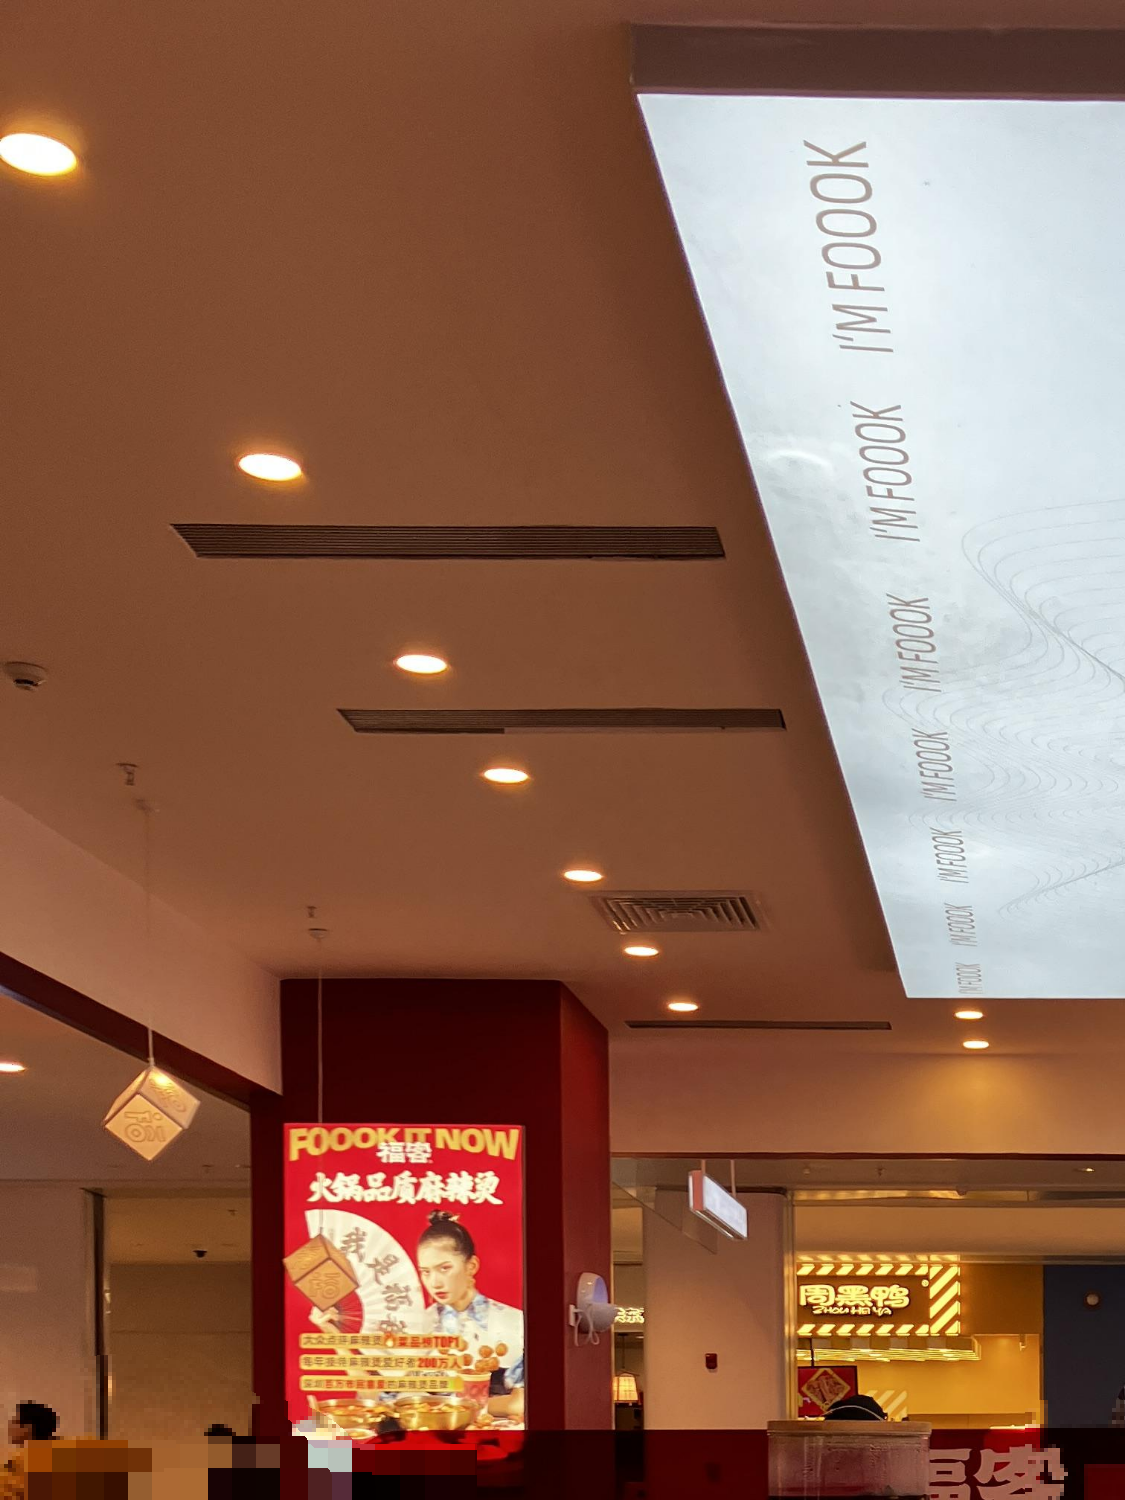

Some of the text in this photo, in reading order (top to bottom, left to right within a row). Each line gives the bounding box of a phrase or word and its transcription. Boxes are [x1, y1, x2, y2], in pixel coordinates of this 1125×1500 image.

[803, 139, 893, 352] I'M FOOOK
[850, 401, 920, 542] I'M FOOOK
[886, 593, 942, 692] I'M FOOOK
[911, 728, 957, 801] I'M FOOOK
[289, 1127, 400, 1161] FOOOK
[435, 1128, 520, 1160] NOW
[375, 1141, 432, 1163] 福客
[306, 1170, 504, 1205] 火锅品质麻辣烫
[800, 1284, 910, 1308] 周黑鸭
